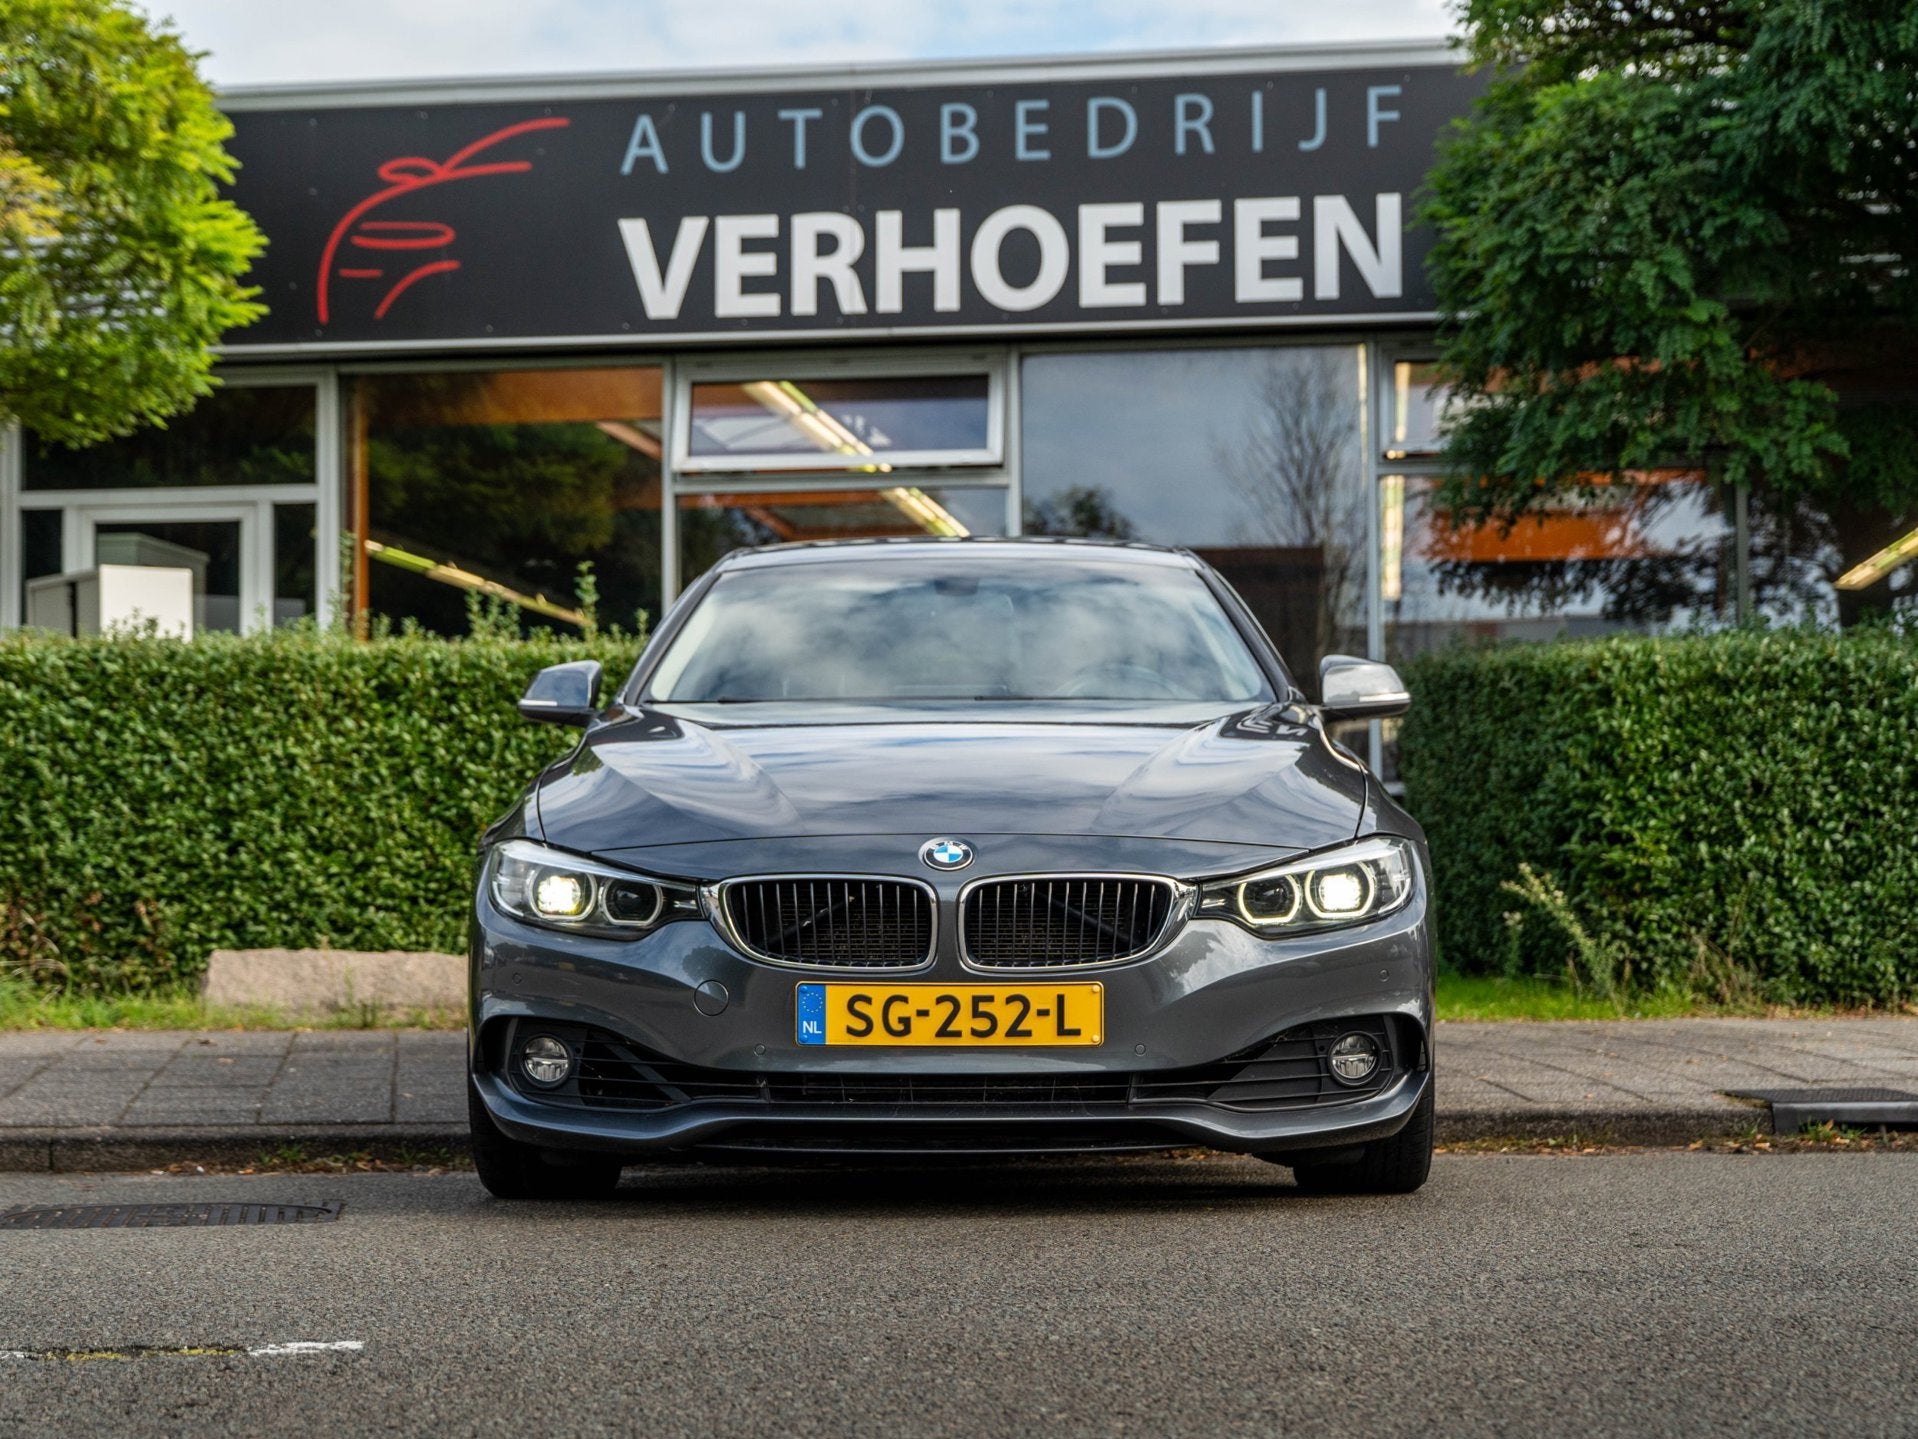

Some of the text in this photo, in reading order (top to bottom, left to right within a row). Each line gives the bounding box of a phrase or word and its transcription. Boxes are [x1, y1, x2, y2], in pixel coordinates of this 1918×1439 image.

[620, 84, 1402, 176] AUTOBEDRIJF
[617, 192, 1402, 320] VERHOEFEN
[802, 1020, 822, 1034] NL
[845, 993, 1082, 1039] SG-252-L
